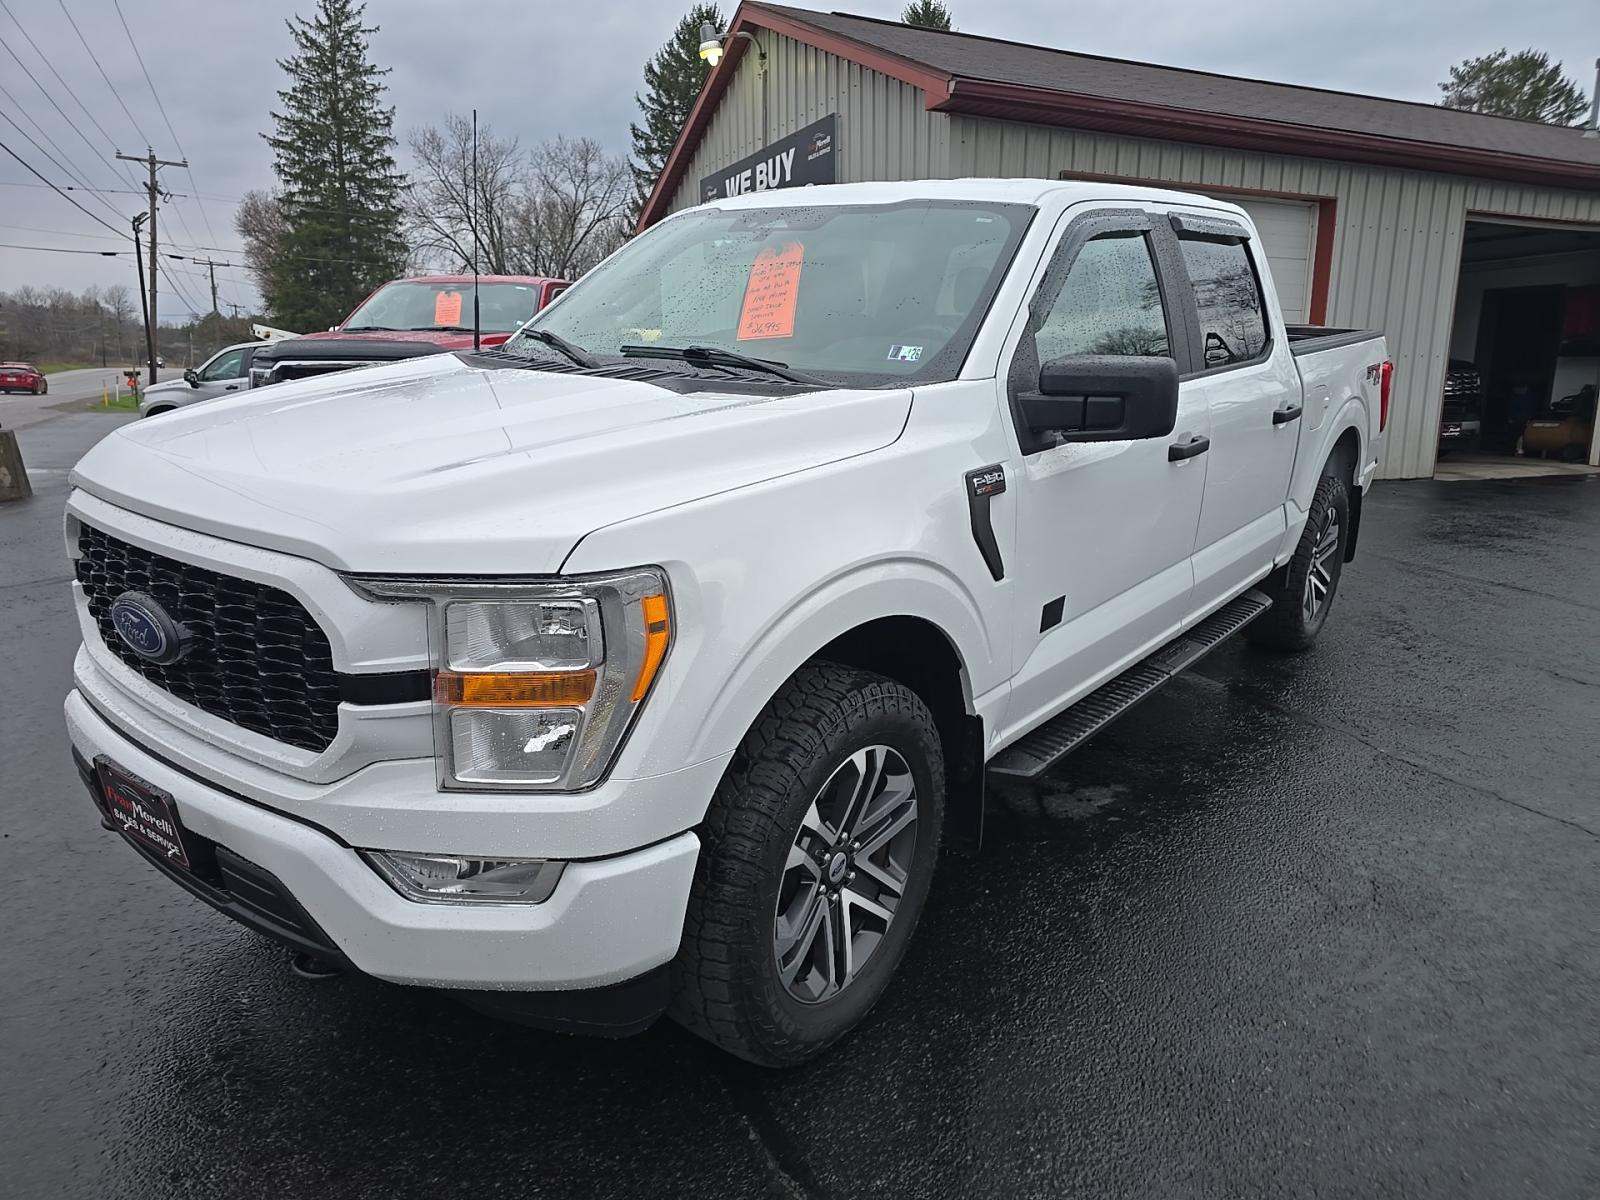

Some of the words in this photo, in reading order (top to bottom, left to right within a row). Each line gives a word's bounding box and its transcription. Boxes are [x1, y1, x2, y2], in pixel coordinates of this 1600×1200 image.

[725, 169, 751, 197] WE
[756, 147, 796, 191] BUY
[973, 472, 1004, 487] F-150
[121, 611, 149, 647] Ford
[113, 808, 139, 830] SALES
[146, 828, 181, 856] SERVICE
[132, 800, 173, 836] Morelli
